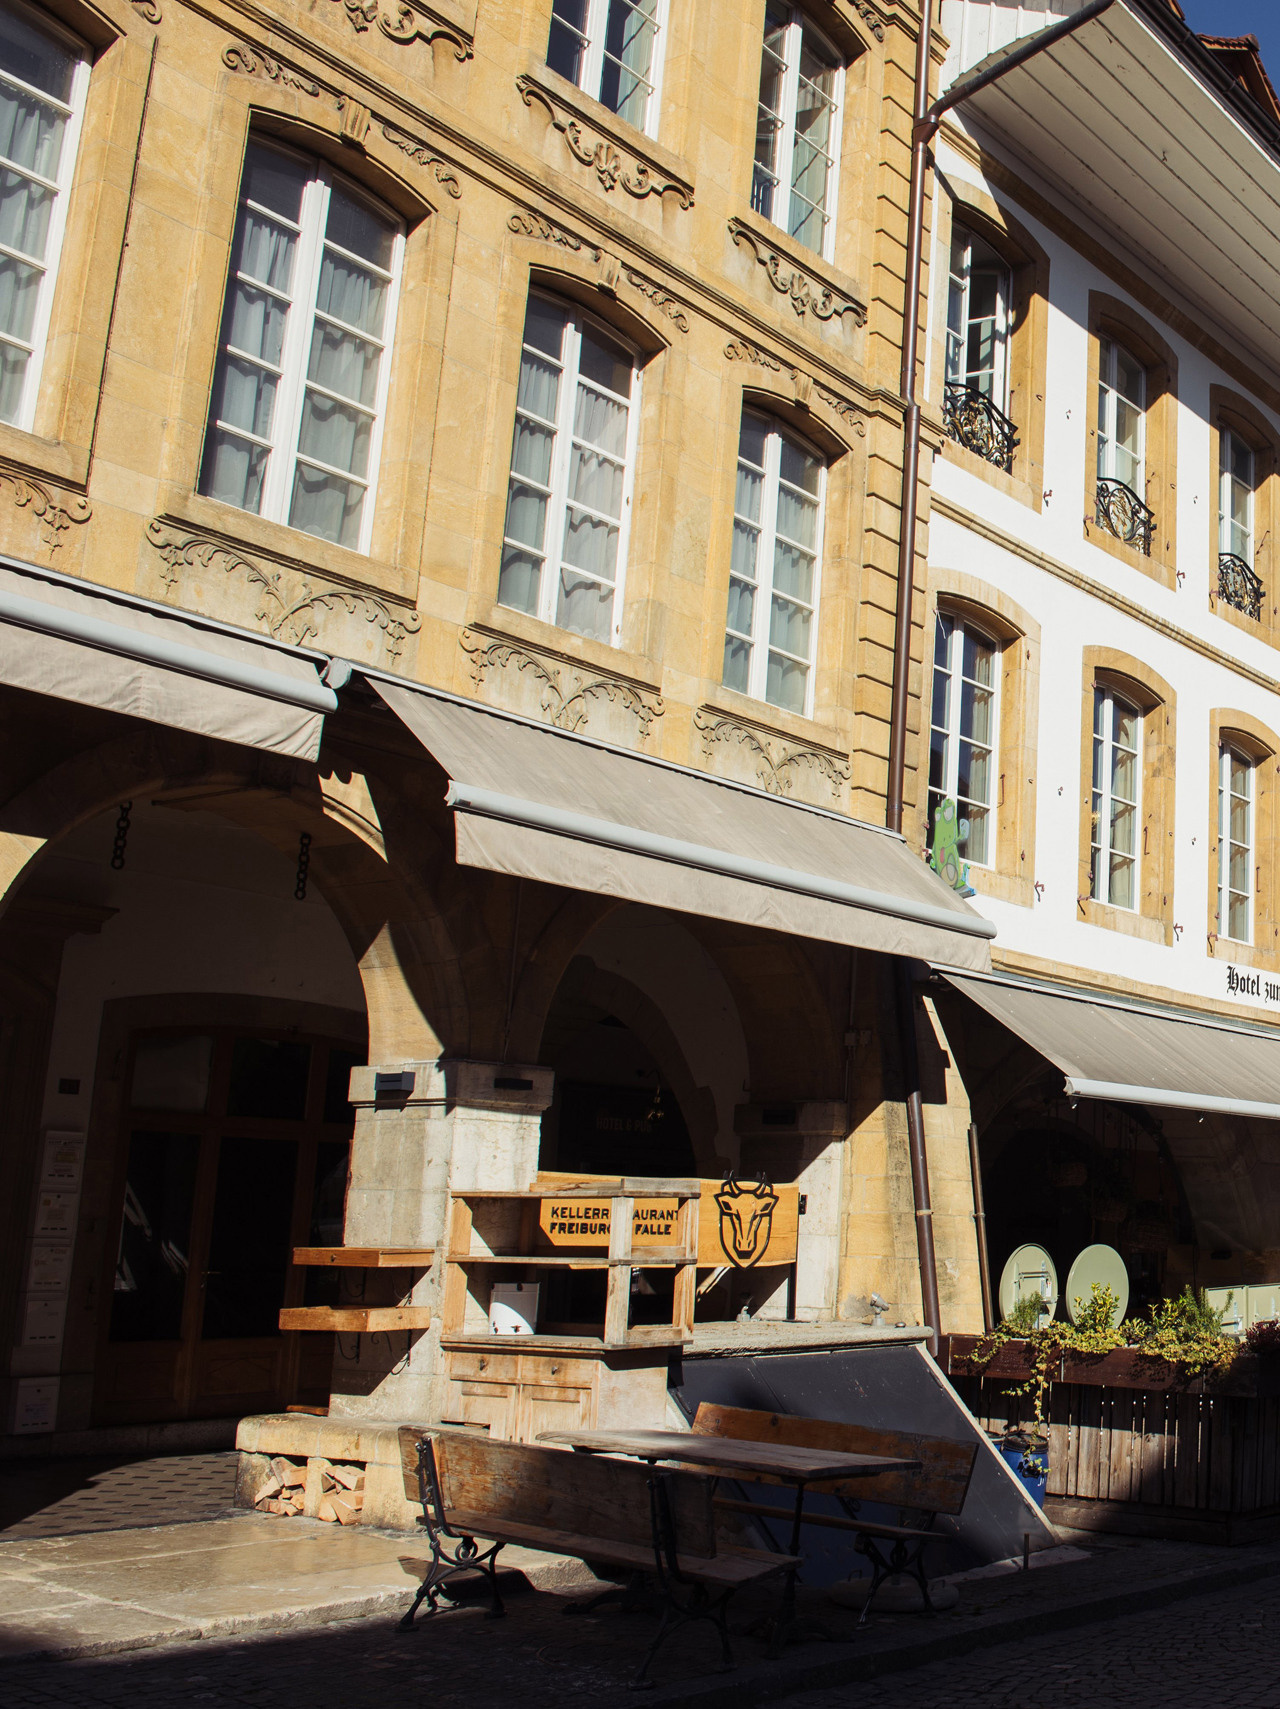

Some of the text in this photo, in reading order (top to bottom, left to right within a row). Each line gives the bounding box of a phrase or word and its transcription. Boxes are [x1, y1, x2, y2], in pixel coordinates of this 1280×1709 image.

[1226, 965, 1261, 997] Hotel
[551, 1206, 679, 1221] KELLERRAURANT
[549, 1222, 672, 1236] FREIBUR FALLE
